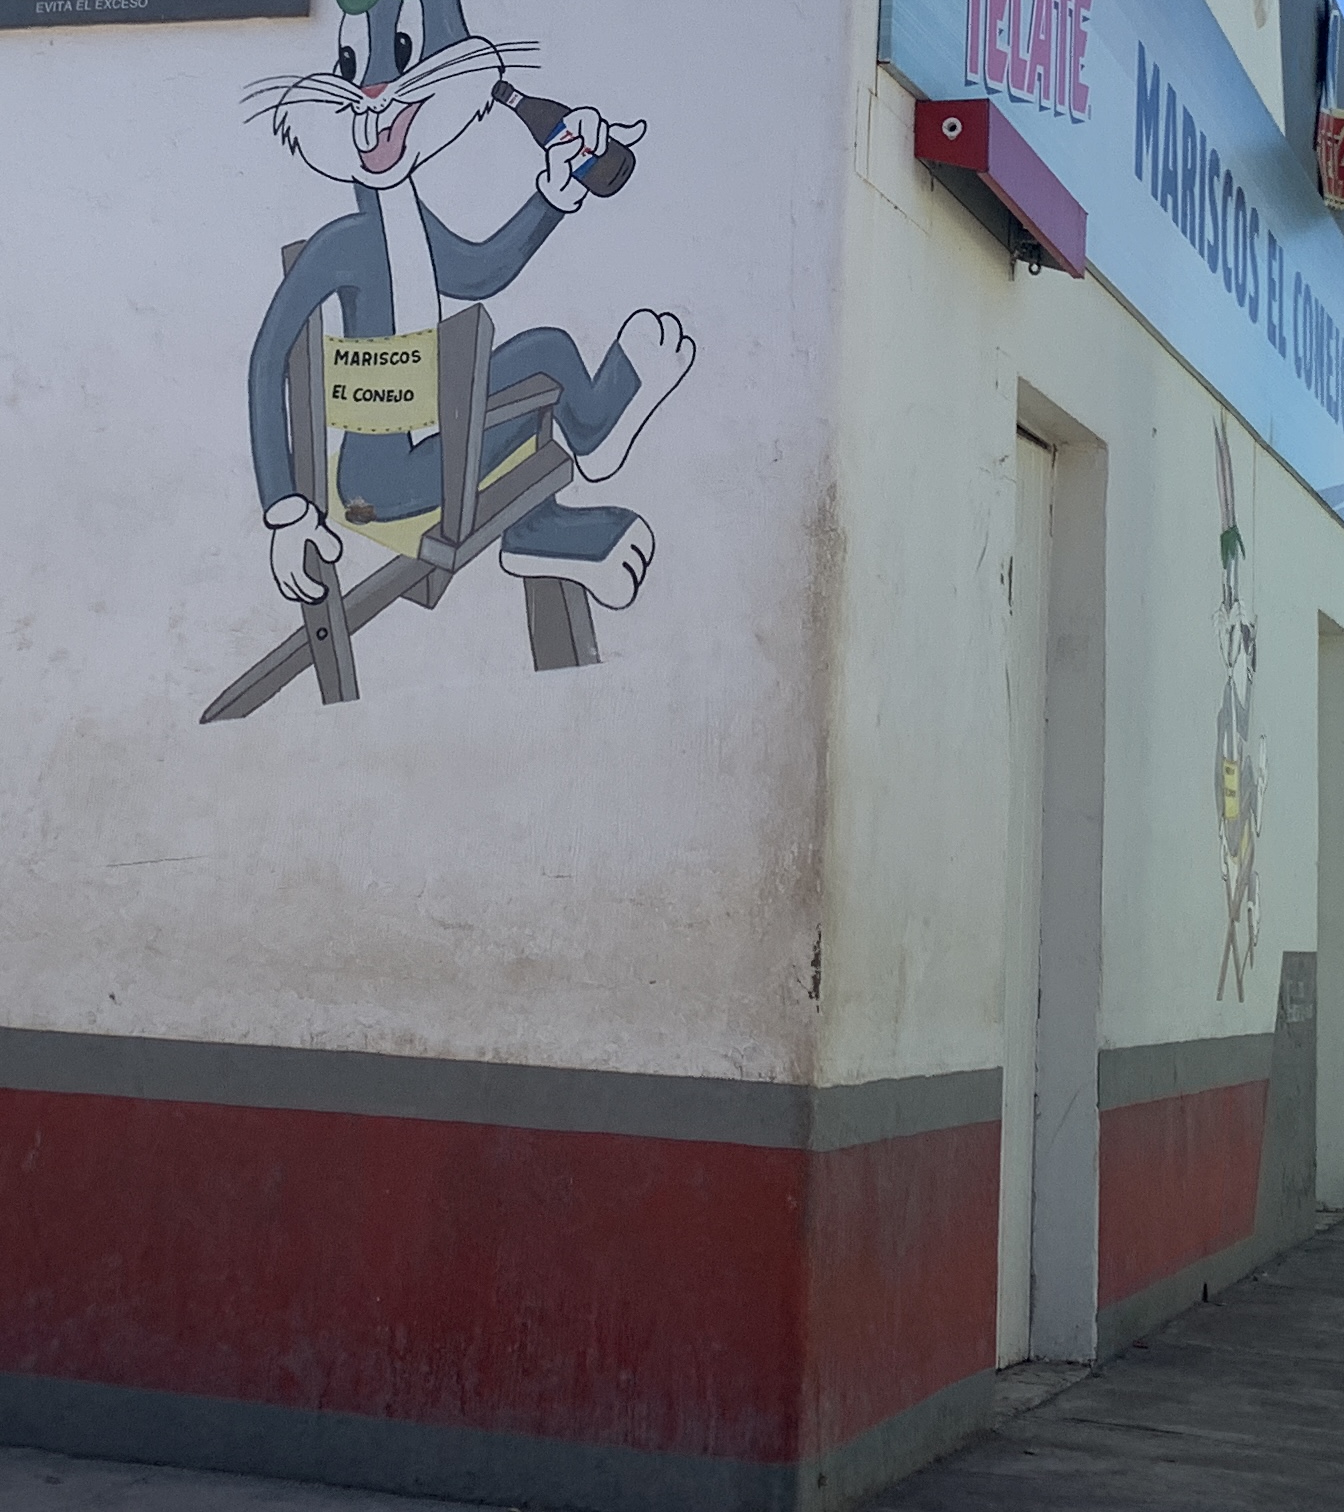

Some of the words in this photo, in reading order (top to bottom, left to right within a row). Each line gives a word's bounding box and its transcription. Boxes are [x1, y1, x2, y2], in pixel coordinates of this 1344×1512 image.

[35, 0, 73, 14] EVITA
[1134, 39, 1260, 325] MARISCOS
[1266, 228, 1287, 360] EL
[333, 348, 422, 366] MARISCOS
[332, 384, 348, 400] EL
[352, 387, 415, 403] CONEJO
